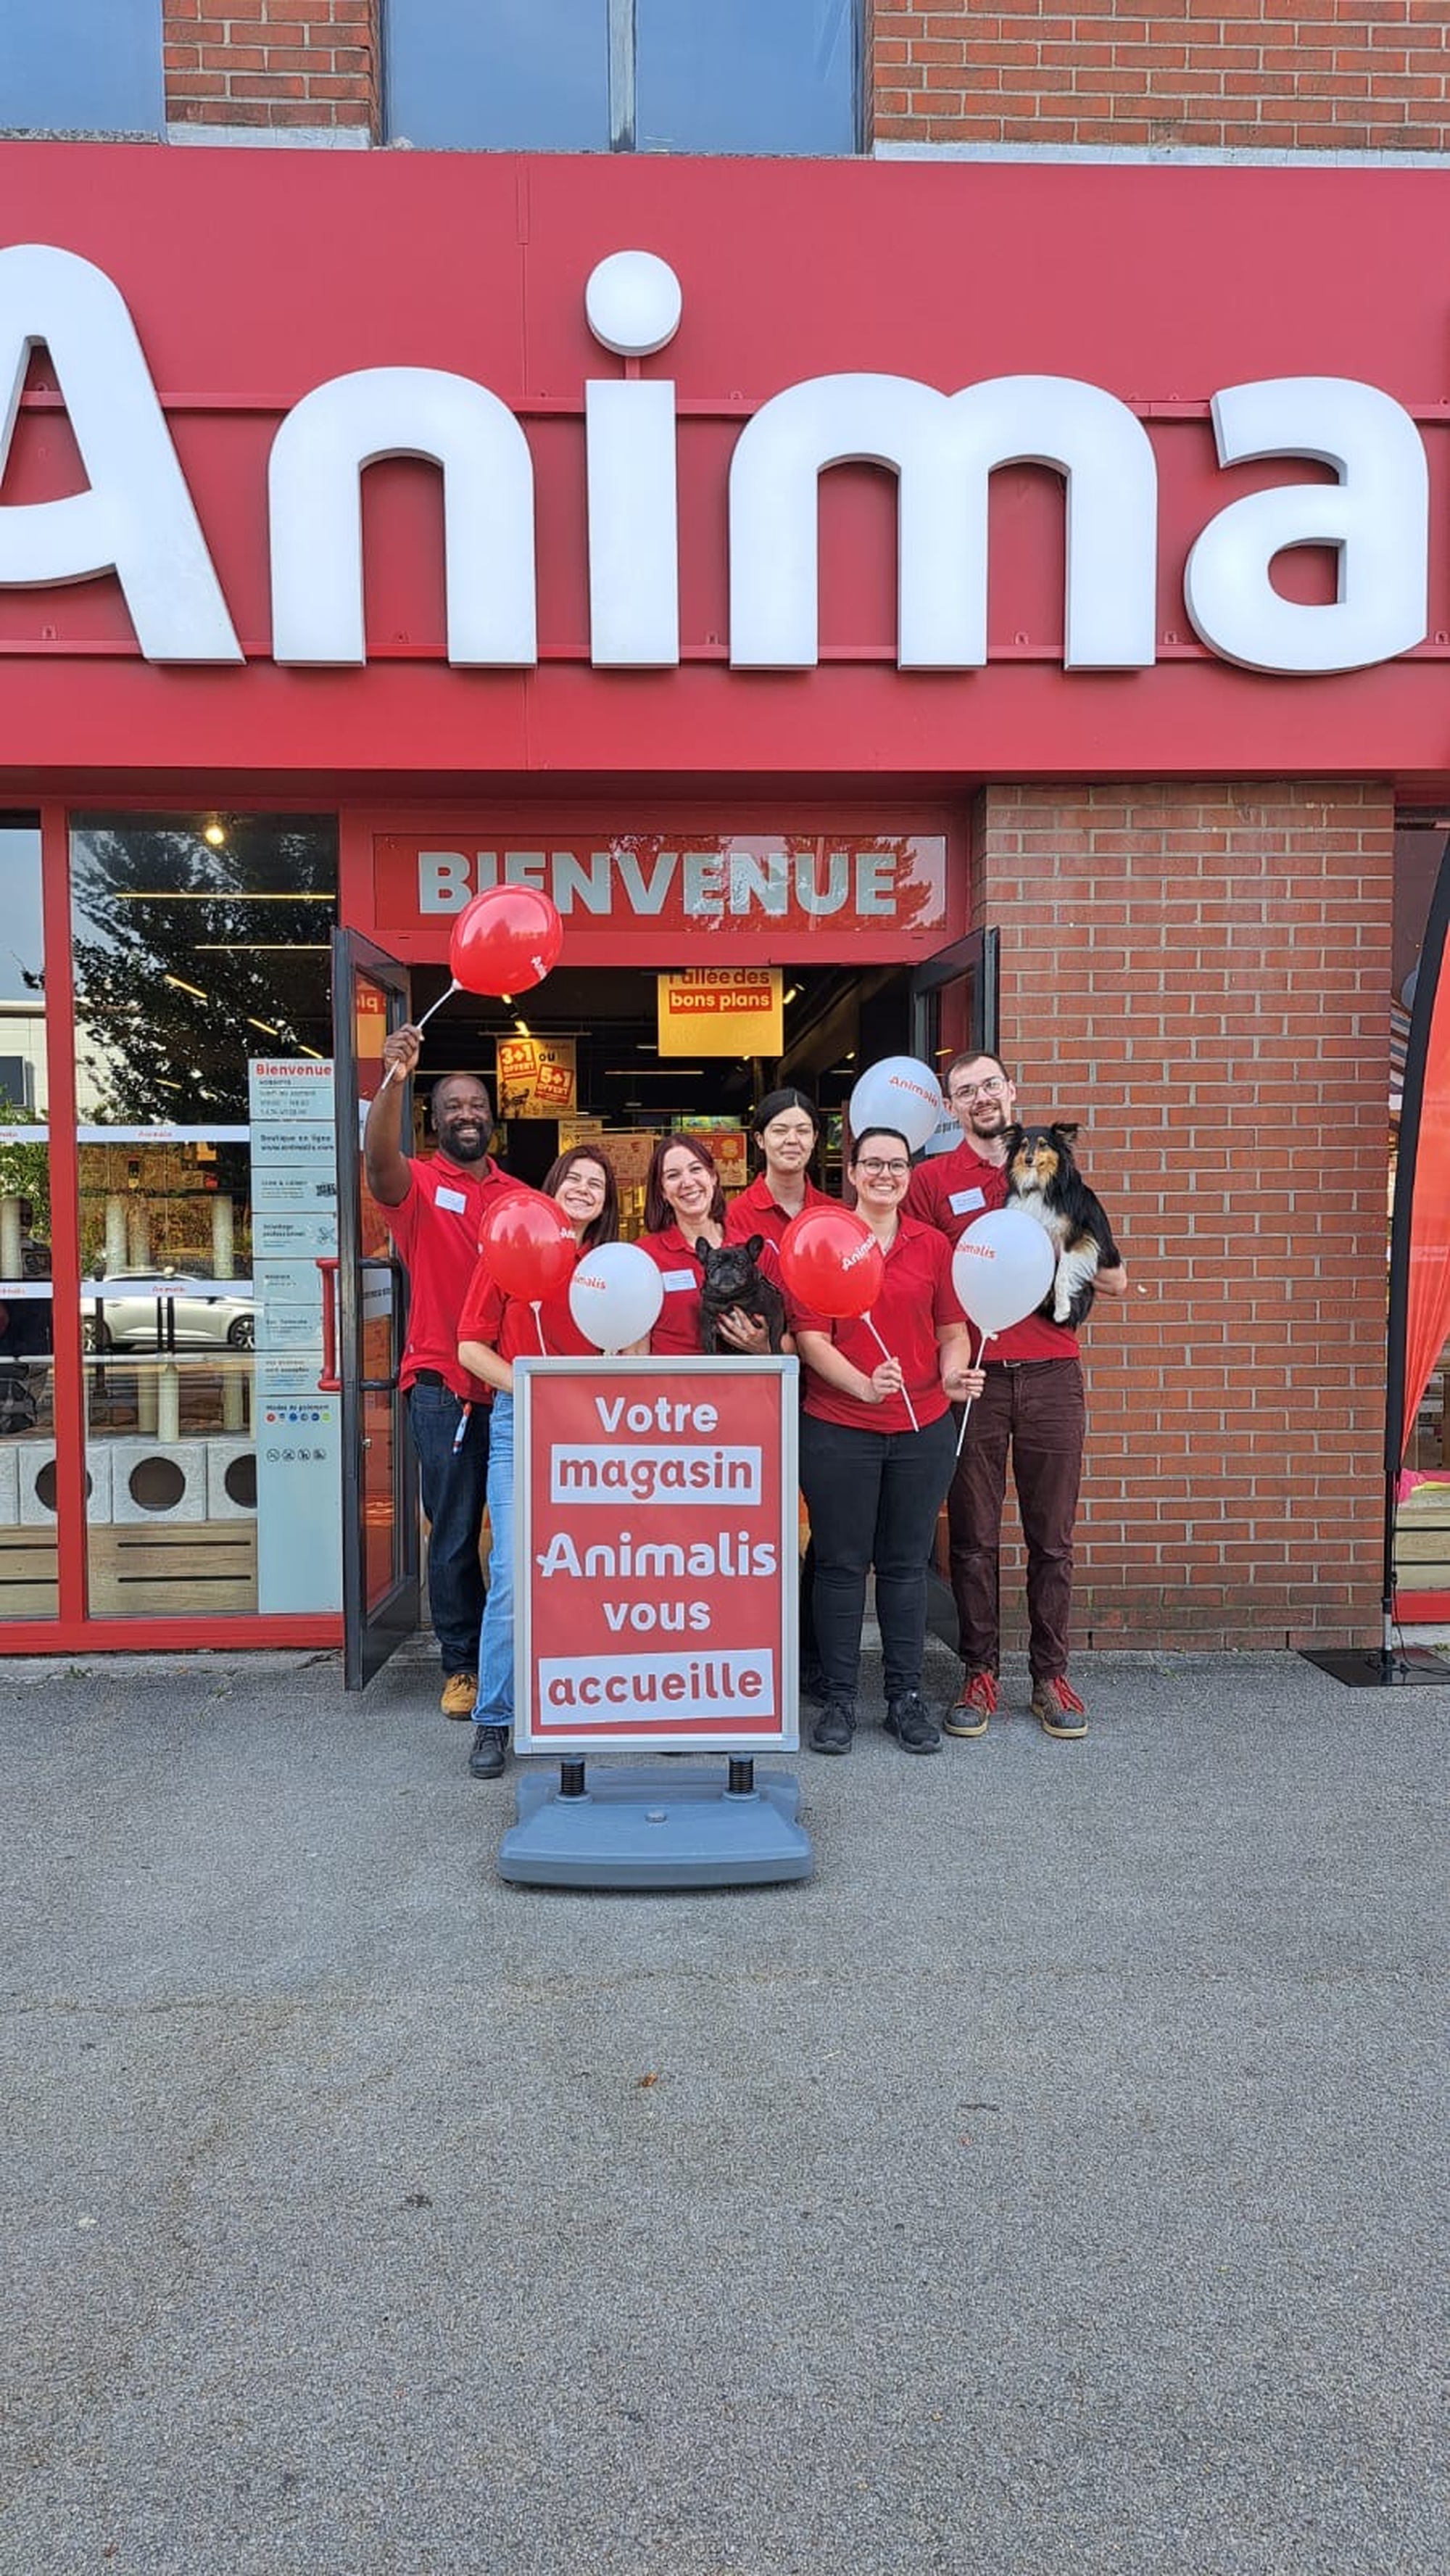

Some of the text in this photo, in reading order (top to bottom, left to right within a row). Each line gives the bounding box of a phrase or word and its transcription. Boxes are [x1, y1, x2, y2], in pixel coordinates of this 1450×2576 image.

[734, 968, 770, 984] des
[671, 991, 770, 1011] bons plans
[501, 1044, 534, 1064] 3+1
[539, 1052, 555, 1062] ou
[256, 1064, 331, 1076] Bienvenue
[540, 1067, 571, 1088] 5+1
[594, 1397, 718, 1432] Votre
[559, 1452, 753, 1500] magasin
[536, 1532, 778, 1578] Animalis
[603, 1601, 711, 1632] vous
[547, 1662, 763, 1706] accueille
